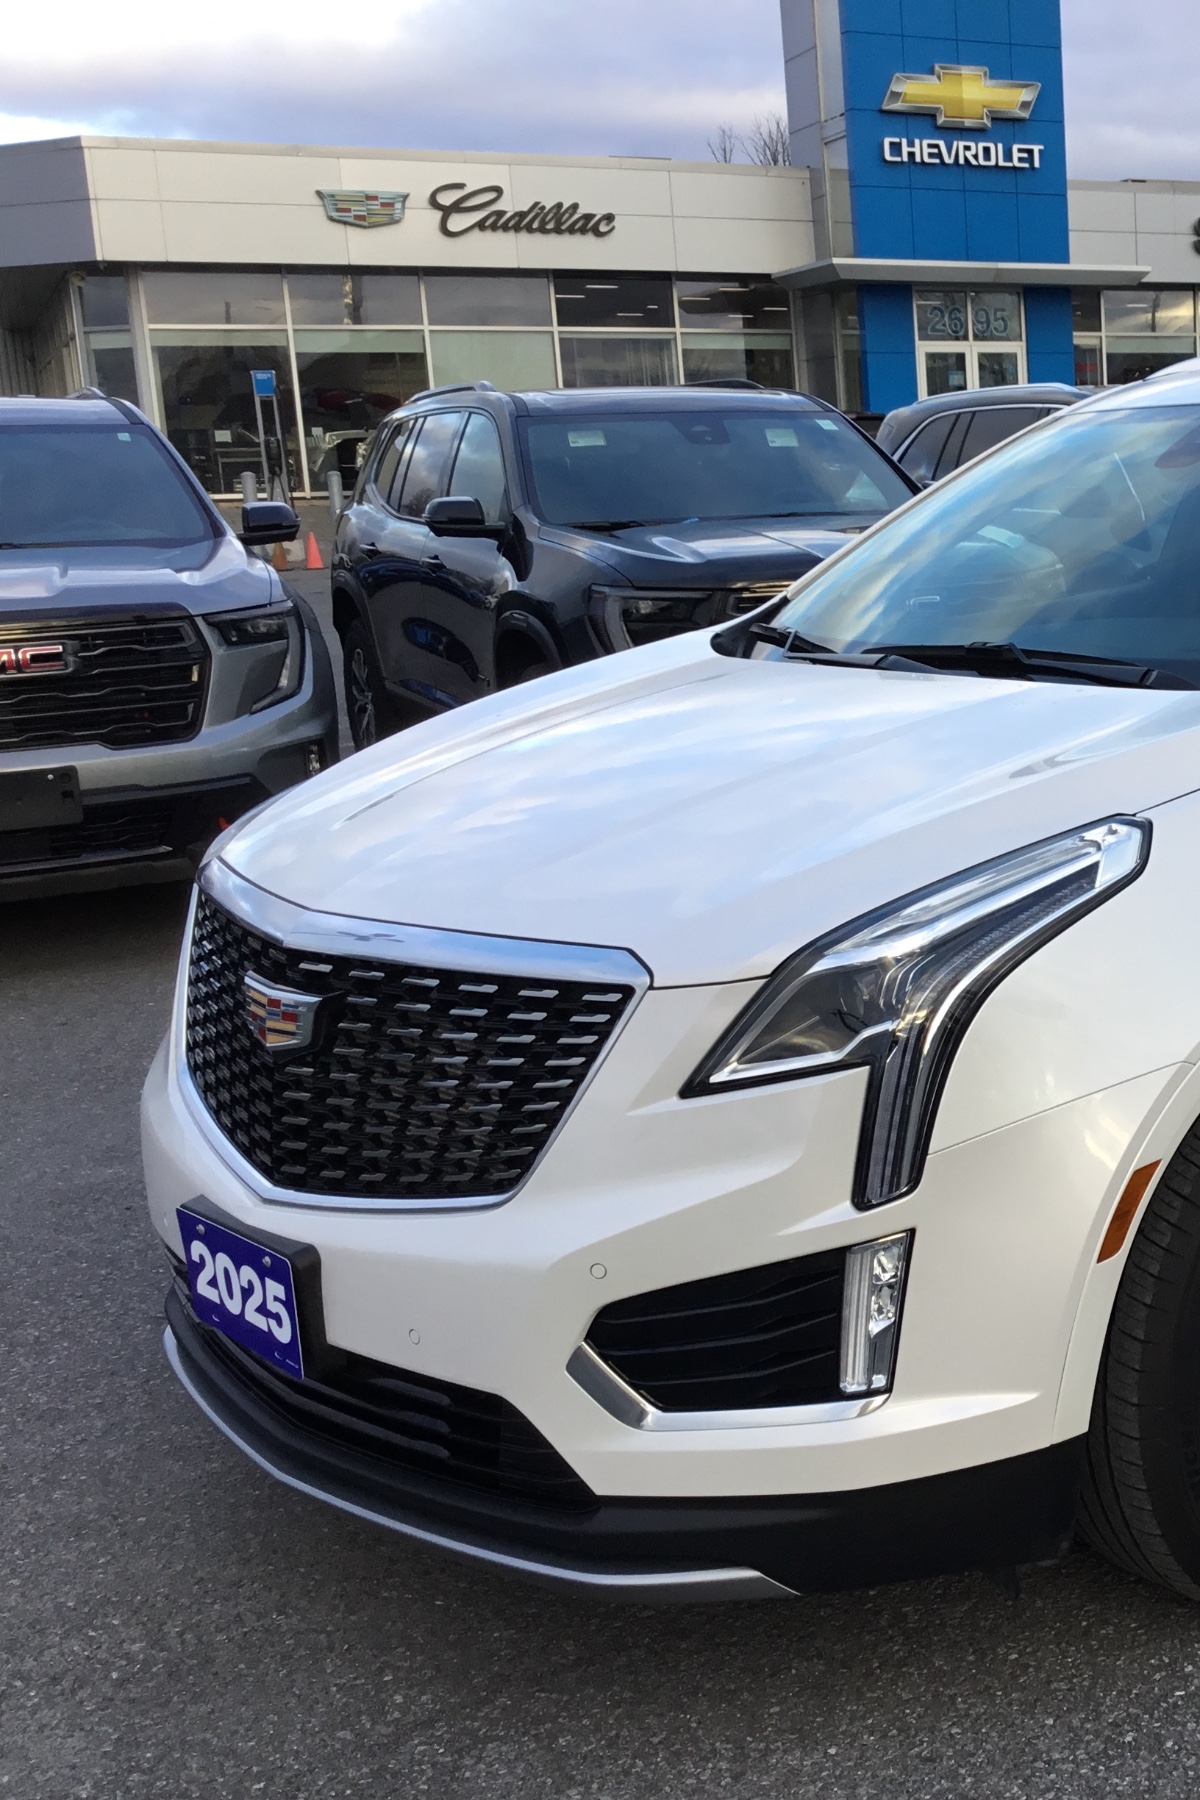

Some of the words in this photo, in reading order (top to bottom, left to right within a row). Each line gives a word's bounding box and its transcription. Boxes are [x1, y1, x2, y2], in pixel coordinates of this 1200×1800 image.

[883, 136, 1045, 169] CHEVROLET
[428, 182, 616, 237] Cadillac
[927, 305, 1010, 336] 2695
[190, 1240, 292, 1344] 2025
